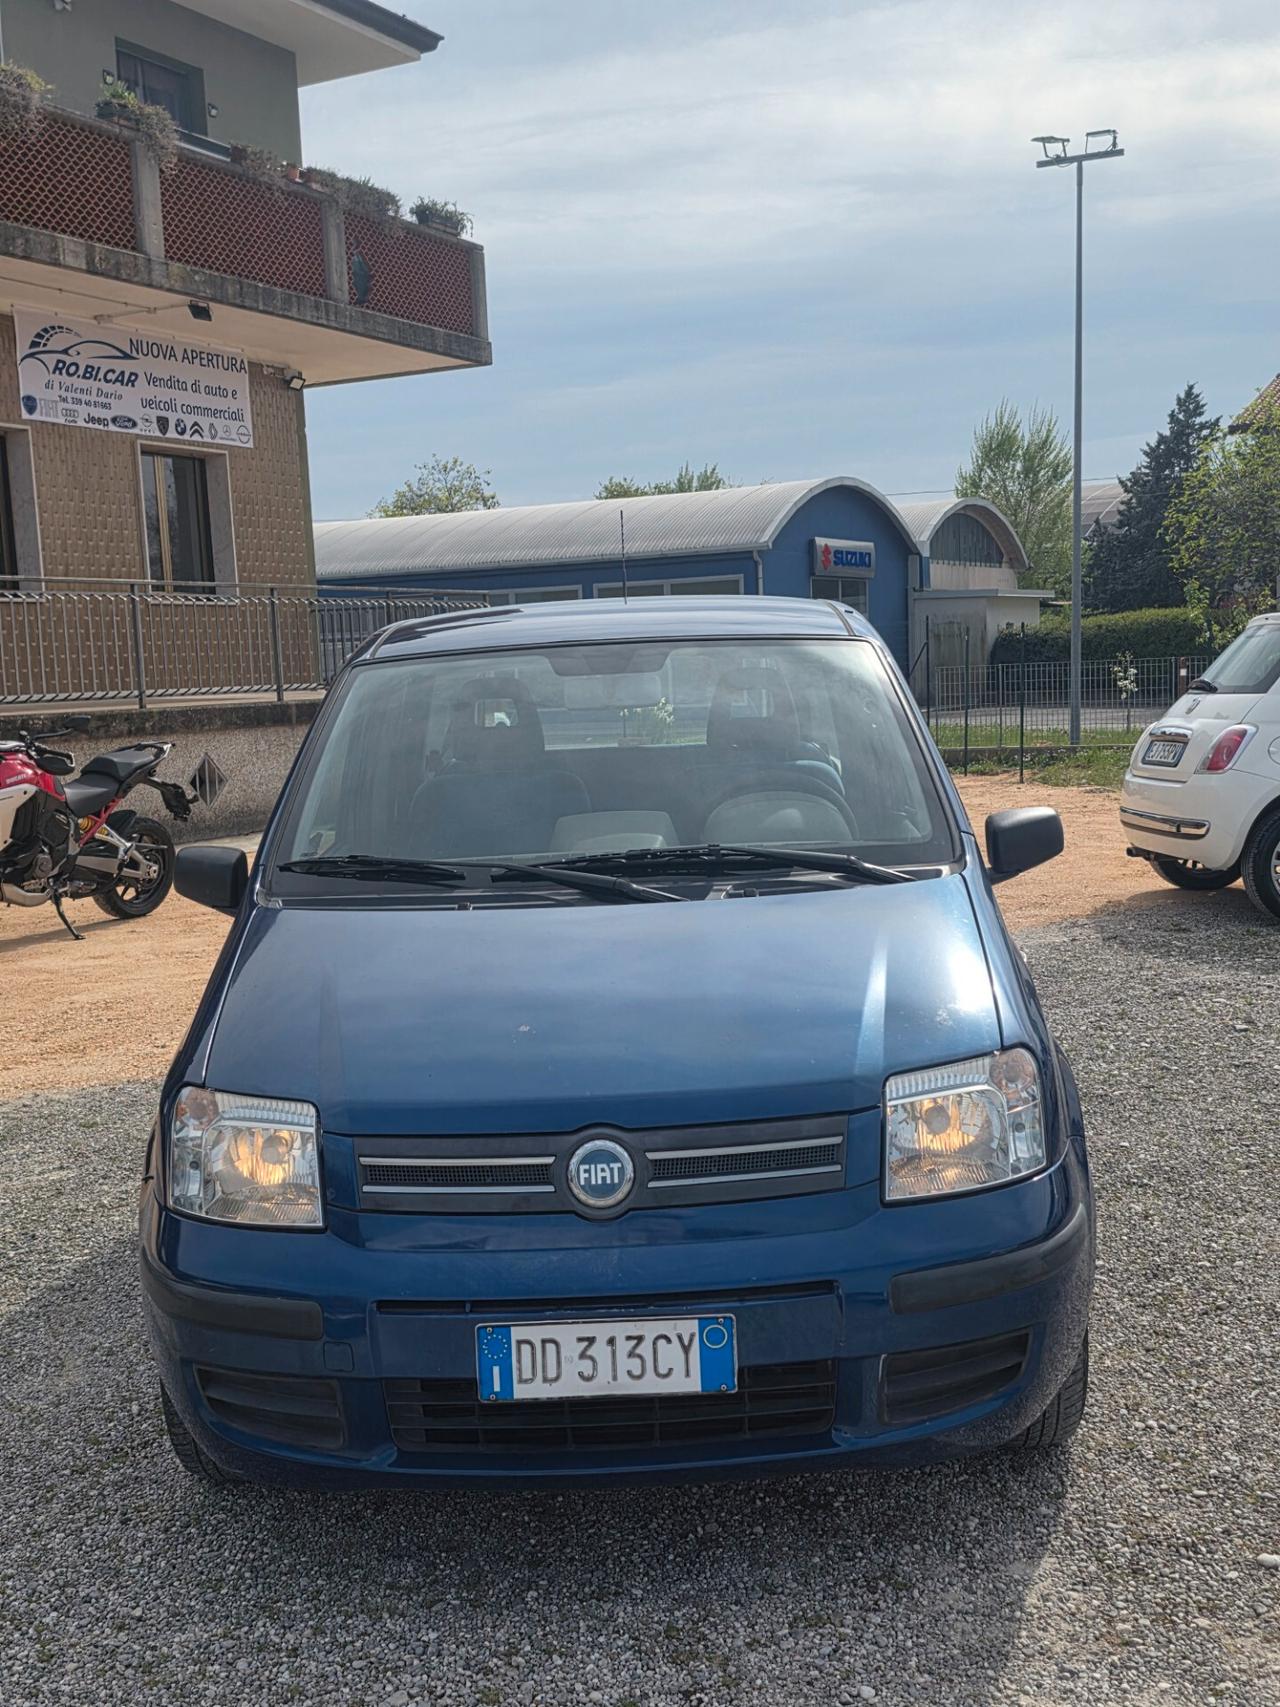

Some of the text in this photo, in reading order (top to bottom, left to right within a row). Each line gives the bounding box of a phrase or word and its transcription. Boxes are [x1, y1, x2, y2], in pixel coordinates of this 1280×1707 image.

[128, 338, 248, 374] NUOVA APERTURA
[52, 359, 139, 388] RO.BI.CAR
[144, 371, 238, 400] Vendita di auto e
[44, 379, 124, 401] di Valenti Dario
[83, 412, 109, 429] Jeep
[141, 396, 245, 423] veicoli commerciali
[832, 549, 872, 568] SUZUKI
[578, 1162, 622, 1186] FIAT
